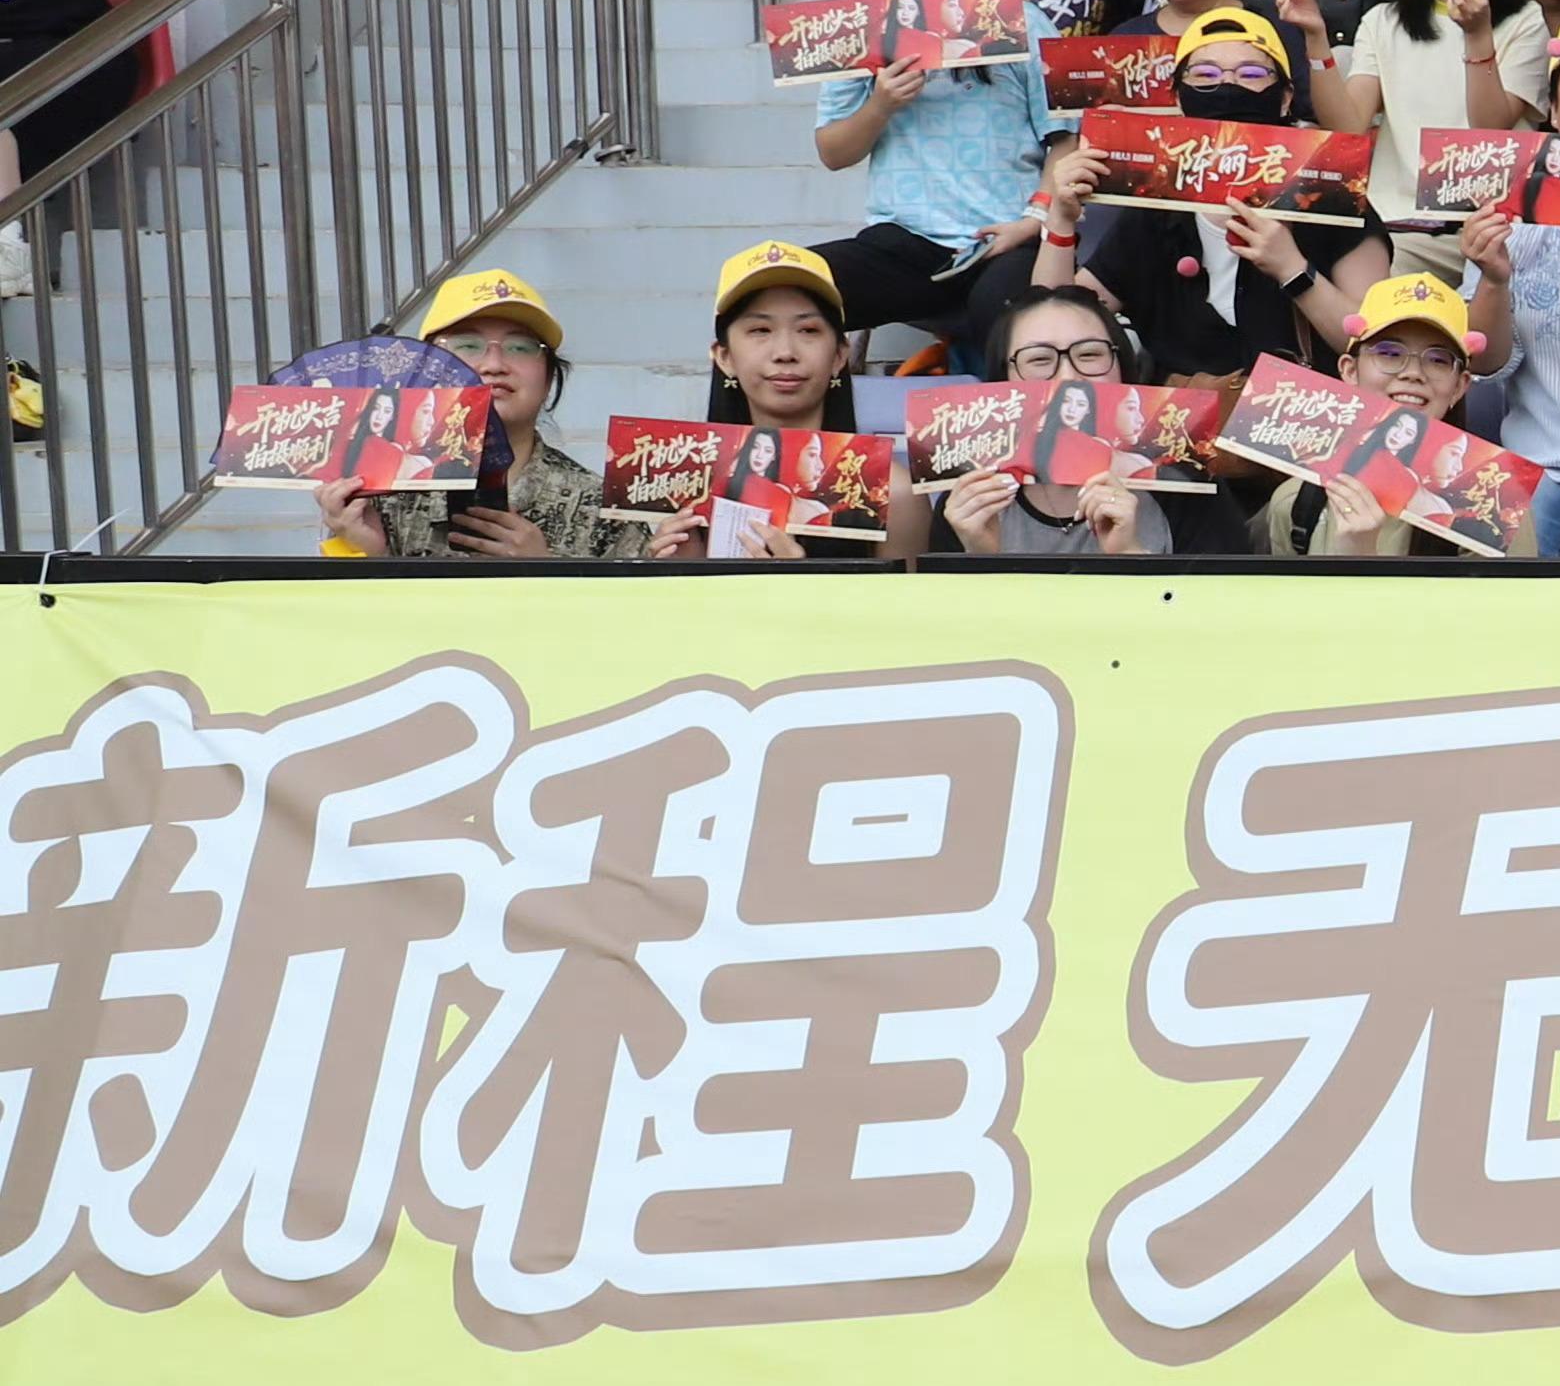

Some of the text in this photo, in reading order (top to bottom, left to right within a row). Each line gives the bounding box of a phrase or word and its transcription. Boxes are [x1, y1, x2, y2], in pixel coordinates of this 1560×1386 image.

[779, 3, 868, 49] 开机大吉
[1113, 50, 1178, 101] 陈丽
[1170, 138, 1293, 194] 陈丽君
[1427, 139, 1519, 177] 开机大吉
[237, 395, 345, 441] 开机大吉
[917, 389, 1024, 443] 开机大吉
[1252, 376, 1364, 425] 开机大吉
[617, 431, 722, 476] 开机大吉
[0, 653, 1075, 1351] 新程
